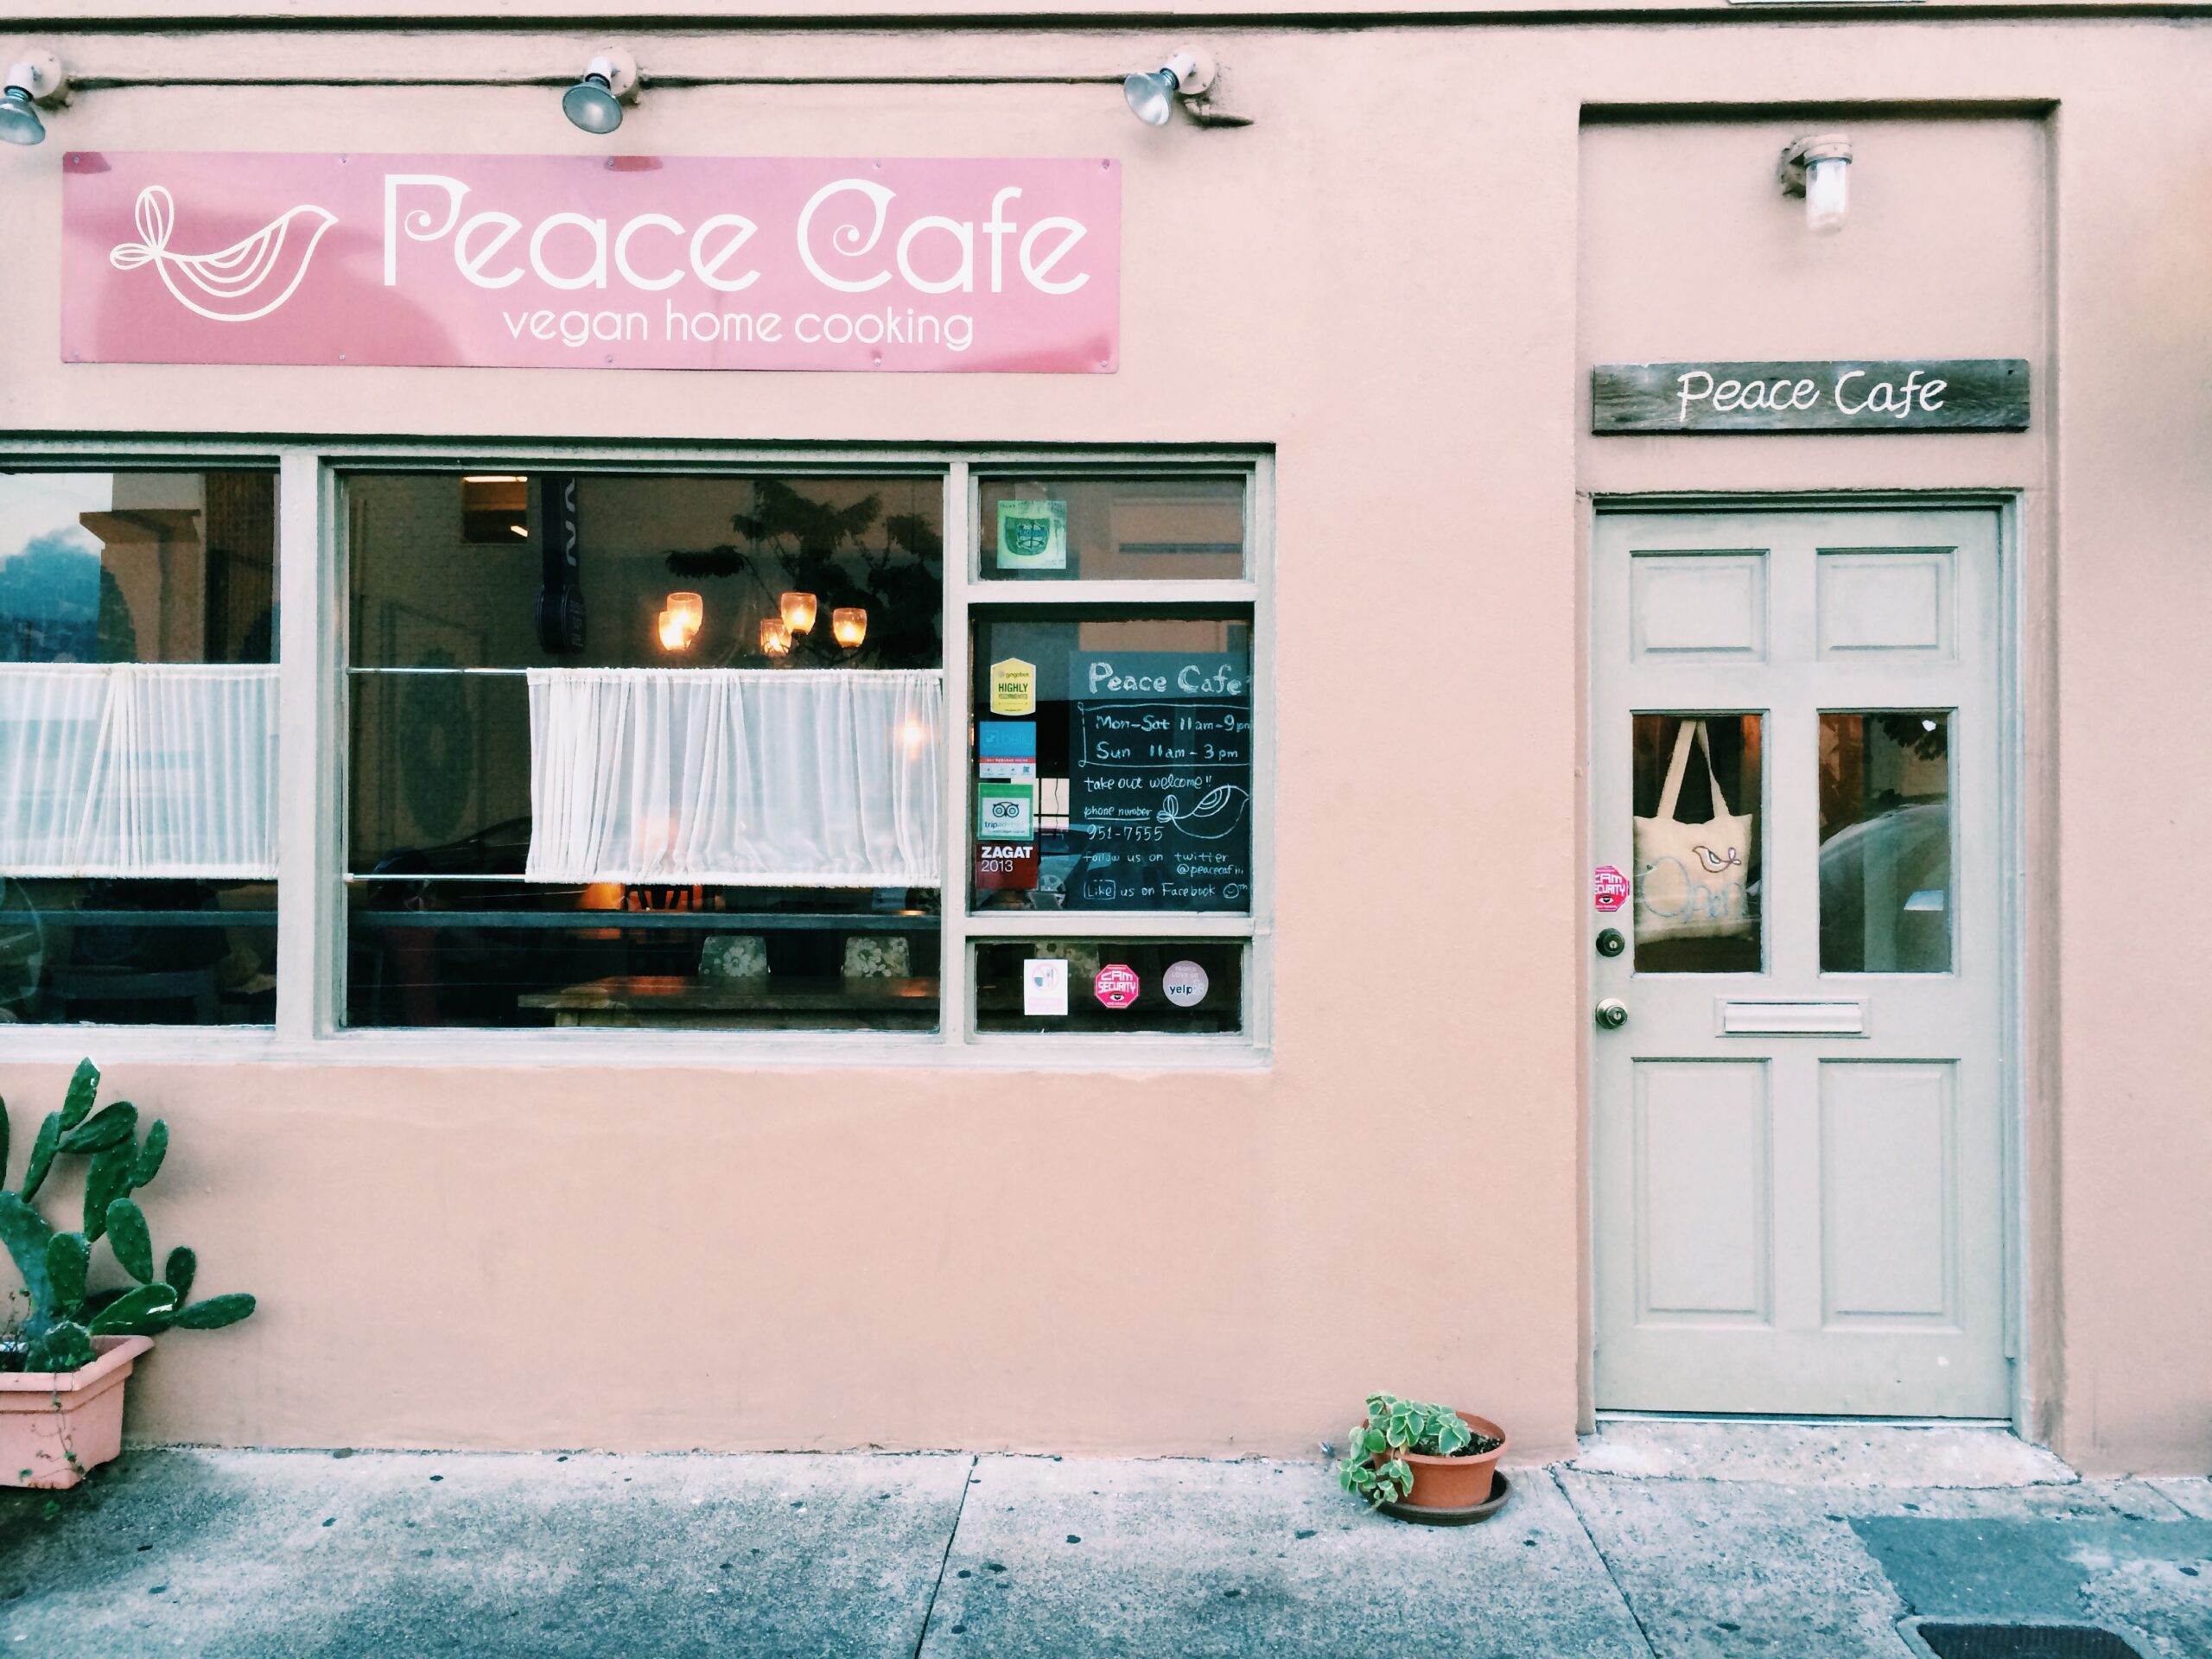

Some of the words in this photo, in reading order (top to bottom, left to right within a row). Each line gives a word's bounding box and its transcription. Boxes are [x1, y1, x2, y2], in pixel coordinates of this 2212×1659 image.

[385, 174, 761, 291] Peace
[797, 178, 1090, 295] Cafe
[502, 309, 648, 347] vegan
[666, 299, 782, 342] home
[795, 307, 973, 351] cooking
[1676, 371, 1820, 423] Peace
[1834, 371, 1948, 418] Cafe
[1089, 662, 1167, 695] Peace
[1177, 664, 1242, 695] Cafe
[998, 683, 1028, 693] HIGHLY
[1096, 741, 1131, 760] Sun
[1084, 777, 1115, 792] take
[1117, 777, 1143, 790] out
[1084, 805, 1115, 818] phone
[1118, 805, 1153, 817] number
[1087, 824, 1165, 841] 951-7555
[982, 847, 1033, 858] ZAGAT
[1127, 854, 1141, 862] us
[1149, 854, 1163, 862] on
[1174, 851, 1229, 863] twitter
[982, 860, 1014, 872] 2013
[1087, 881, 1113, 897] Like
[1121, 887, 1135, 897] us
[1141, 887, 1154, 896] on
[1161, 882, 1216, 897] Facebook
[1595, 884, 1626, 896] CURITY
[1101, 970, 1134, 982] CAM
[1097, 981, 1136, 995] SECURITY
[1169, 984, 1193, 995] yelp
